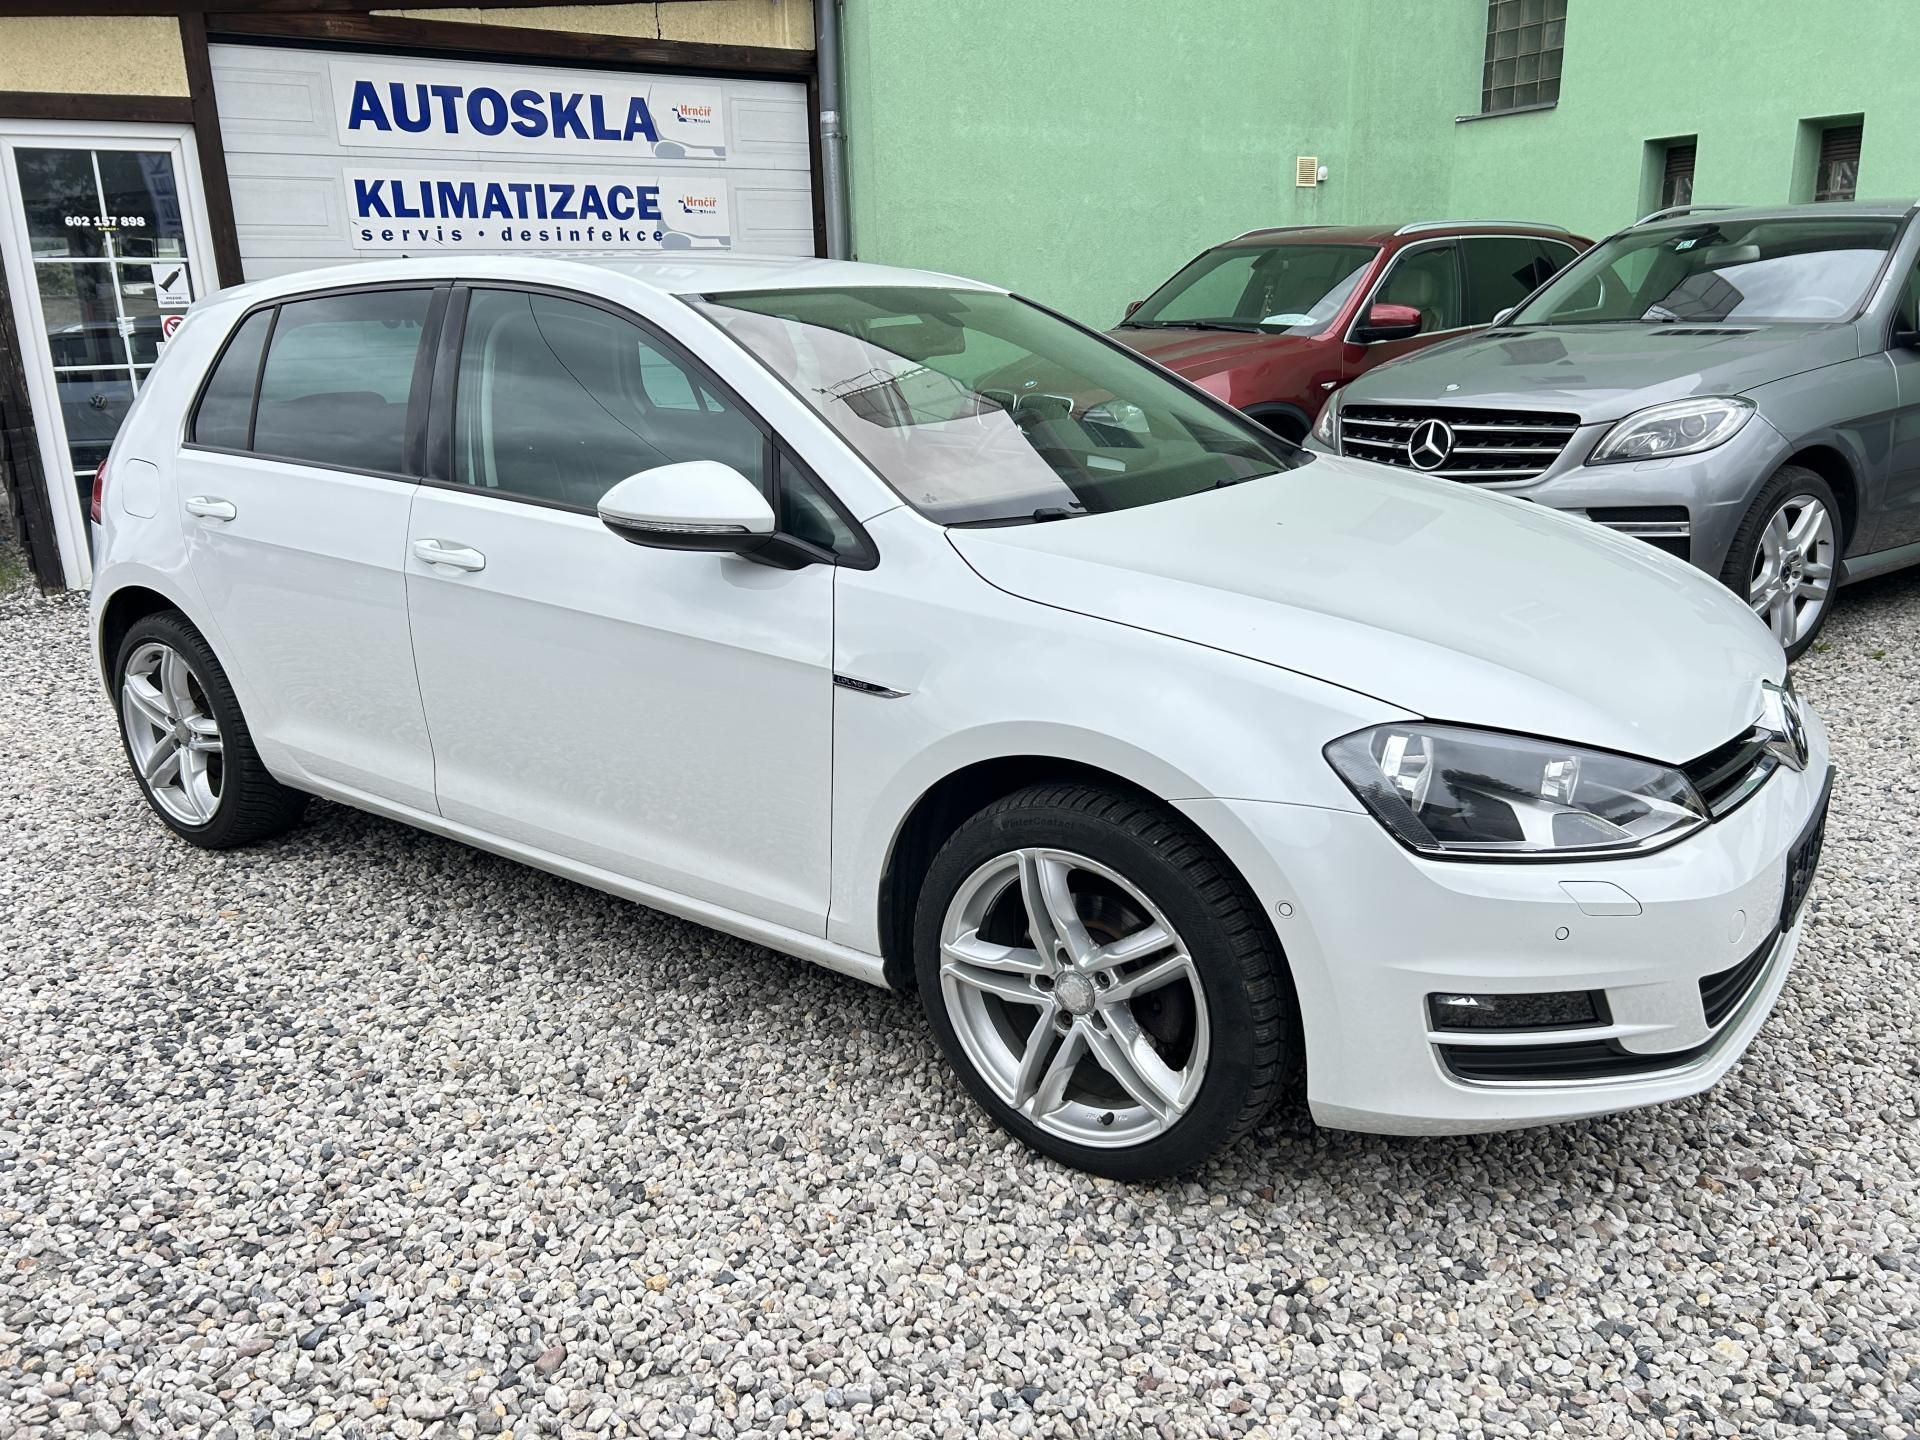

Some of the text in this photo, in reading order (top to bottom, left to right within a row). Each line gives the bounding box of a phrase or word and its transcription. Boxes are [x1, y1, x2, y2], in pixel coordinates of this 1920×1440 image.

[348, 80, 659, 142] AUTOSKLA
[354, 179, 662, 221] KLIMATIZACE
[64, 215, 146, 227] 602 157 898
[360, 225, 664, 242] servis desinfekce
